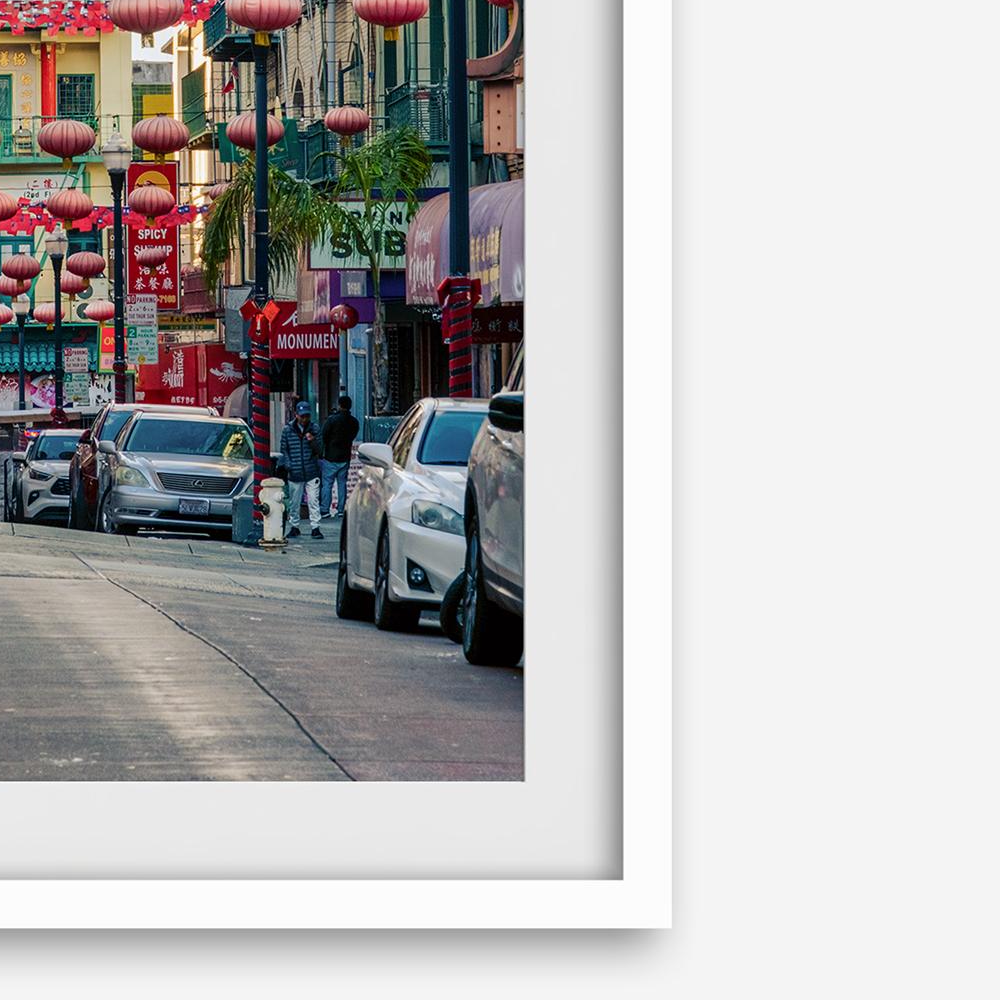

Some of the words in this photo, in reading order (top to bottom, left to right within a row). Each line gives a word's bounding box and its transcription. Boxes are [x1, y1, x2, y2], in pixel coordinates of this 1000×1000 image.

[138, 229, 167, 239] SPICY
[130, 329, 135, 337] 2
[277, 332, 341, 350] MONUMEN
